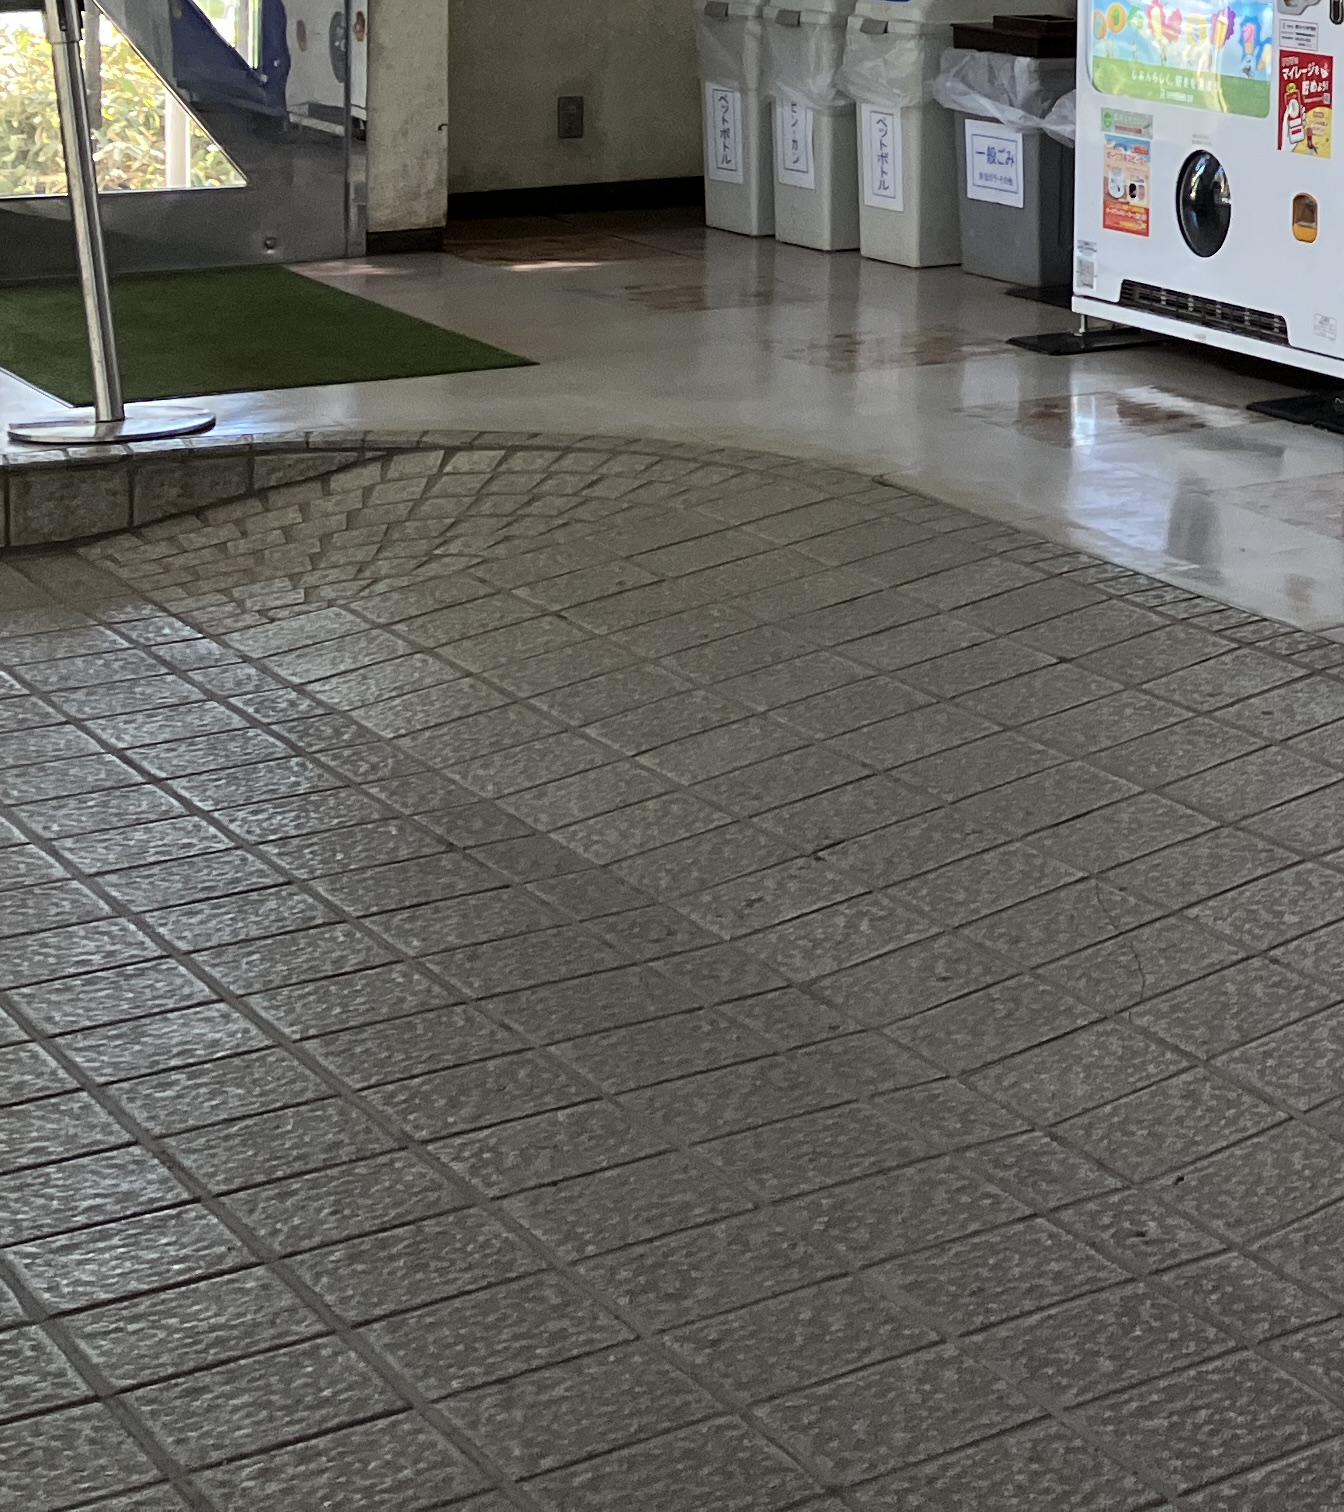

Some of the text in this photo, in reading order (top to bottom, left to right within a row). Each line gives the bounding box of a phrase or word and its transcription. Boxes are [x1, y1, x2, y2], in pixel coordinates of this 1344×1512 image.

[718, 94, 732, 165] ペットボトル
[876, 117, 890, 191] ペットボトル
[975, 145, 1015, 167] 一般ごみ
